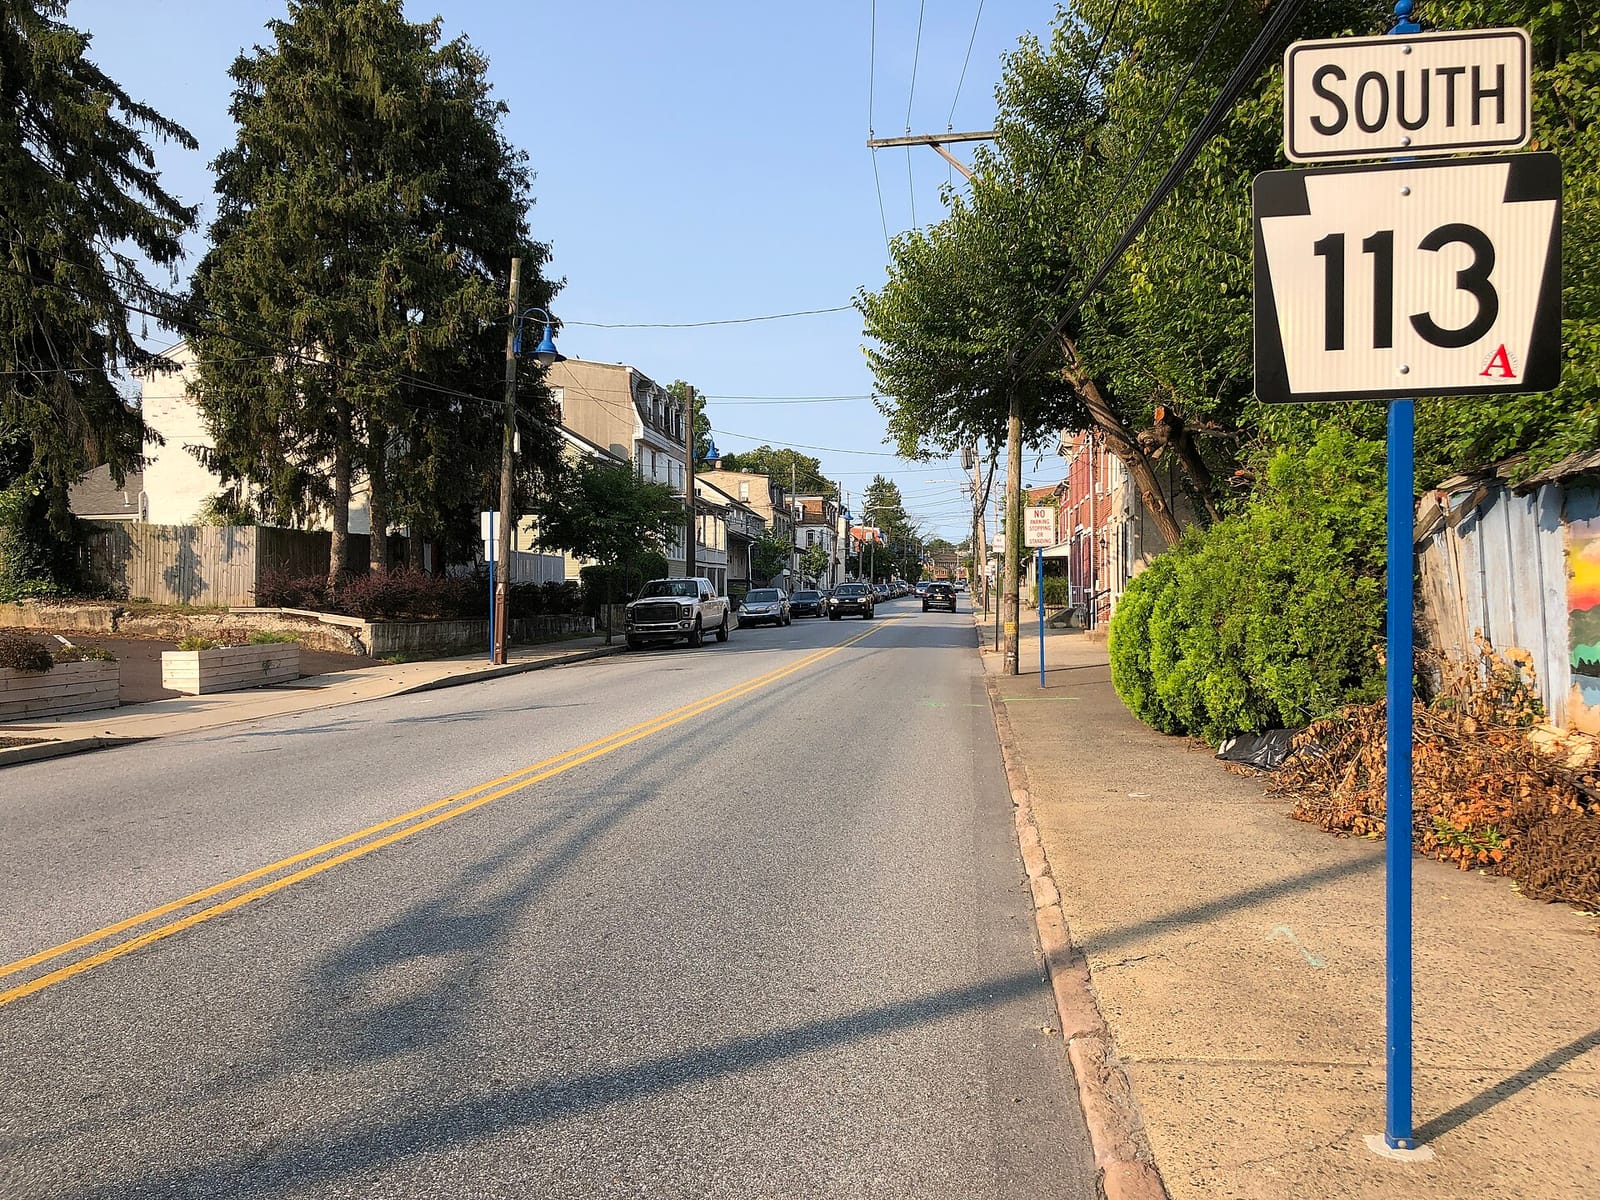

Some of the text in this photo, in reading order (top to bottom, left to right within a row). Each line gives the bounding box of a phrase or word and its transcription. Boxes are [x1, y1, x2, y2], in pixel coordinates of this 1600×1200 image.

[1309, 63, 1506, 136] SOUTH
[1313, 222, 1499, 352] 113
[1479, 343, 1517, 378] A
[1034, 509, 1046, 518] NO
